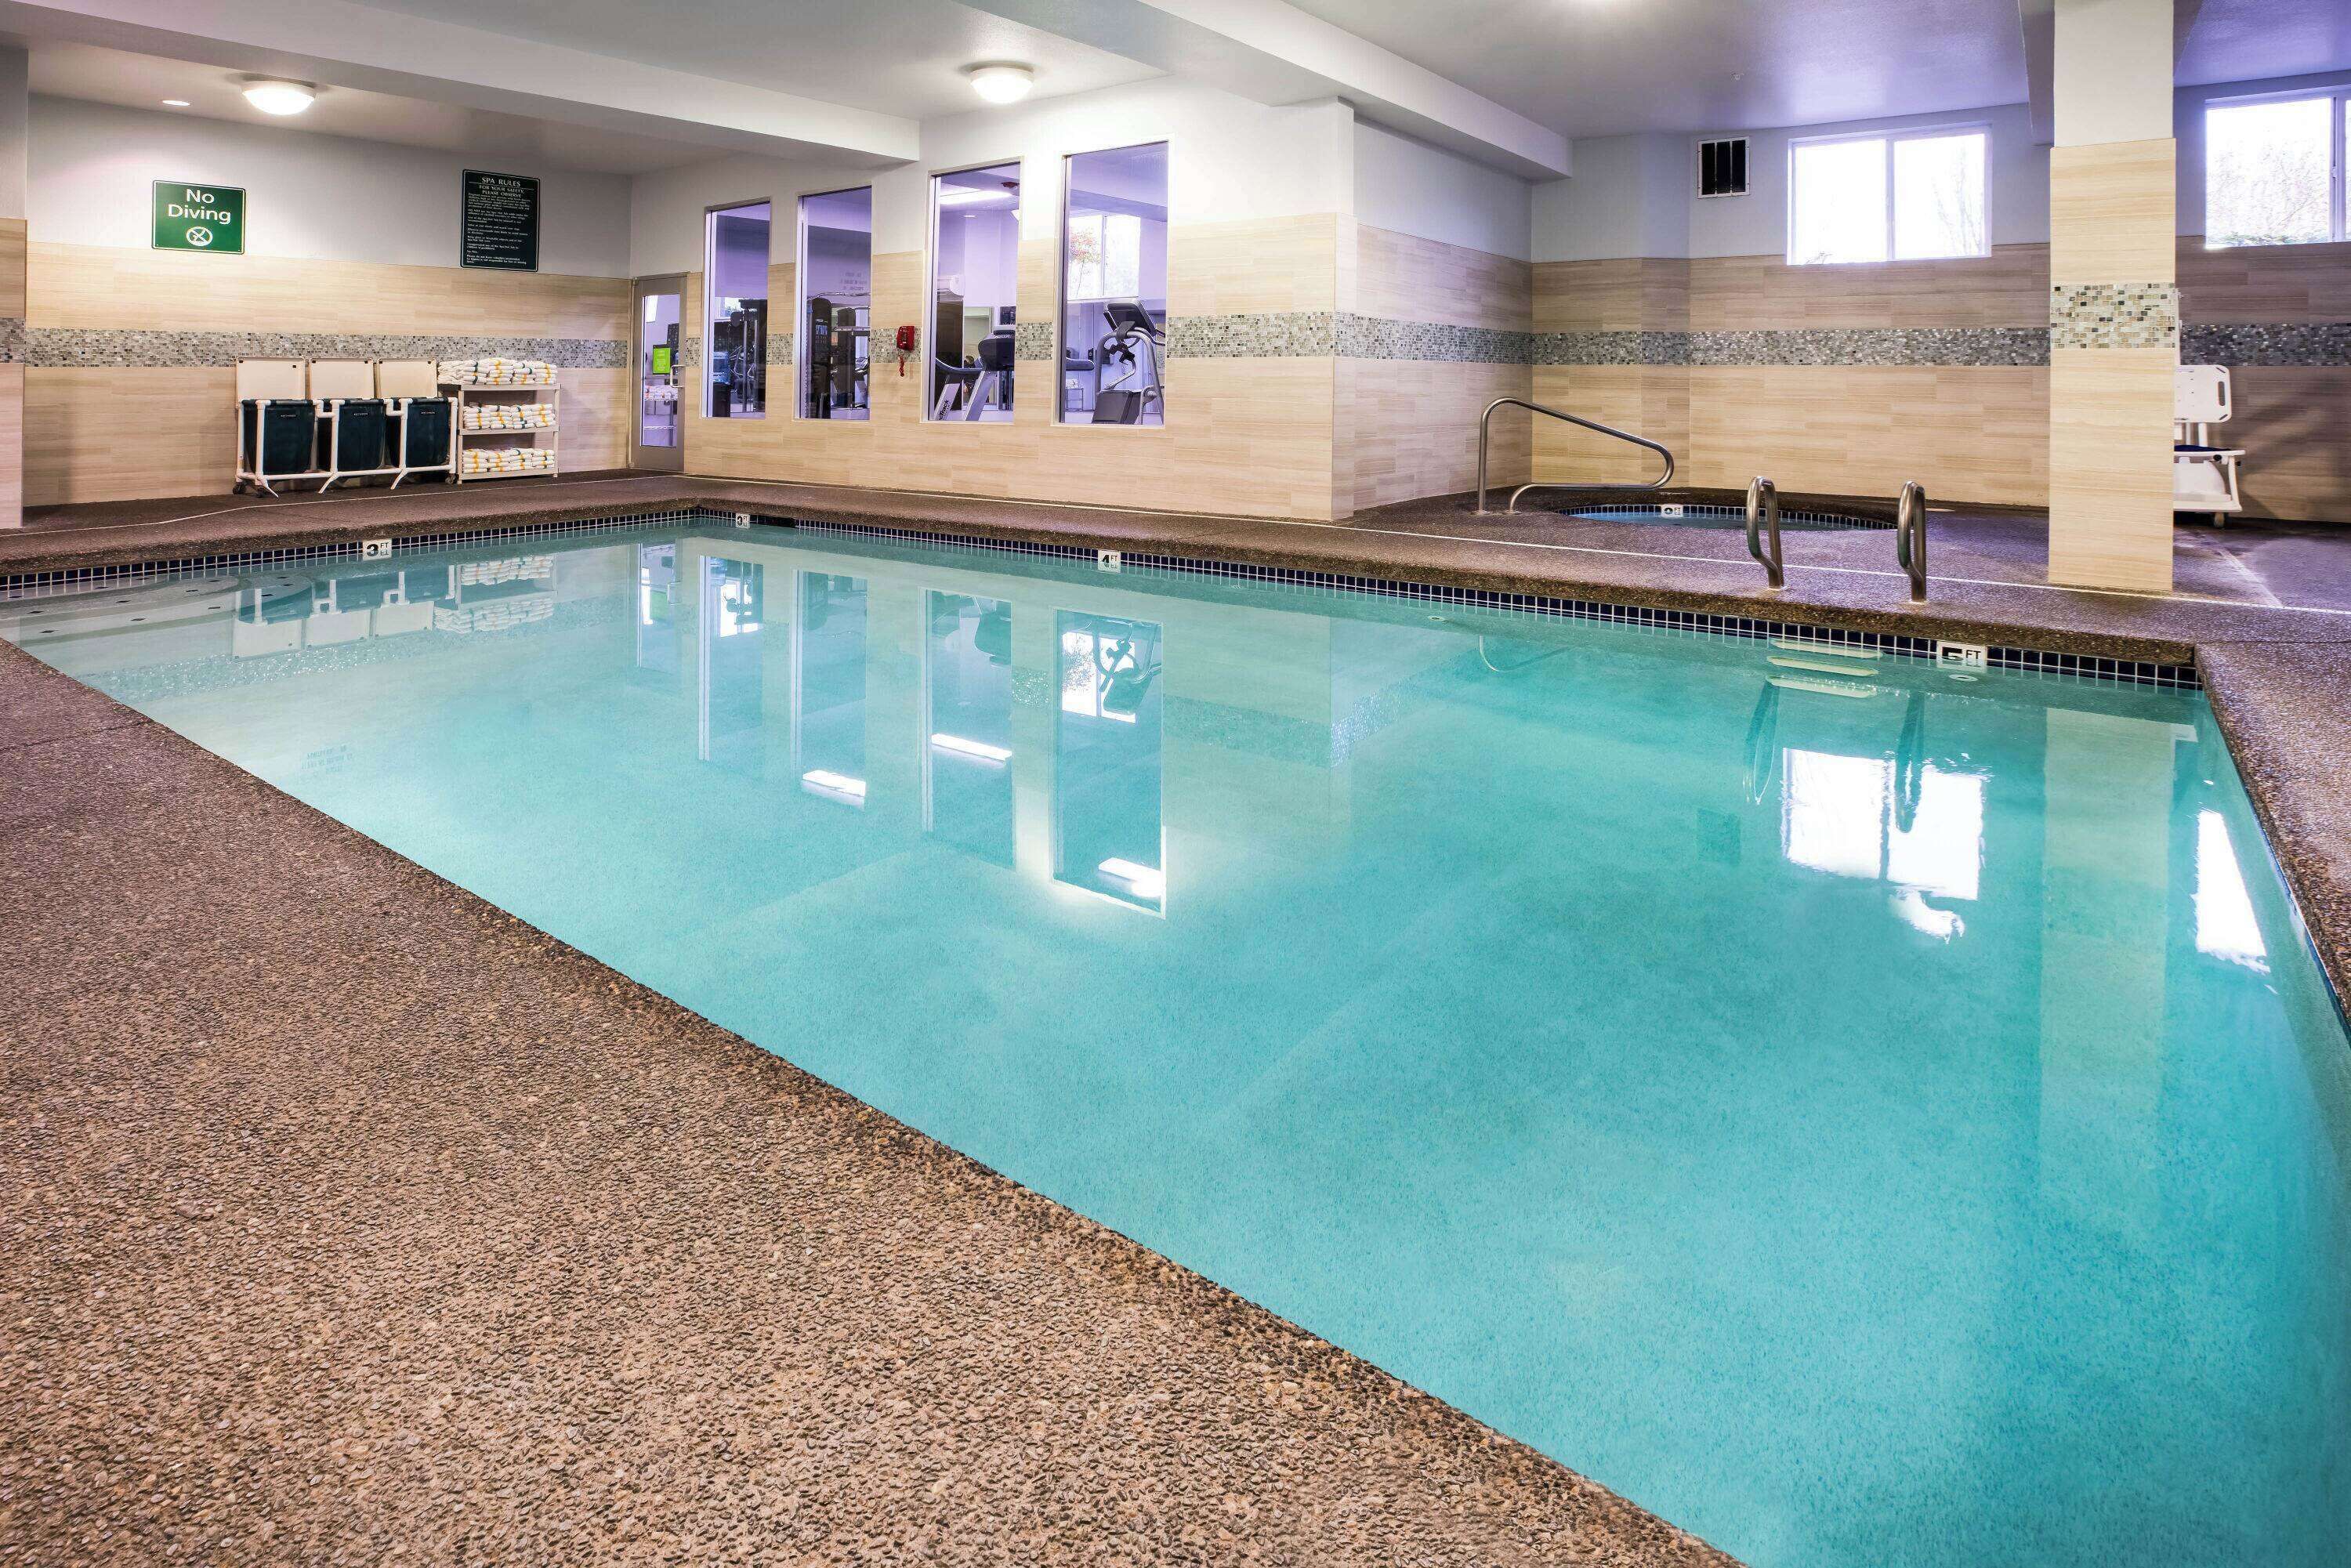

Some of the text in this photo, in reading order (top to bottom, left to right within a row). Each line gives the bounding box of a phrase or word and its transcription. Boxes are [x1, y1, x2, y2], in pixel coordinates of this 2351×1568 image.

[498, 179, 520, 187] RULES
[187, 188, 215, 204] No
[168, 204, 231, 224] Diving
[367, 543, 379, 556] 3
[1102, 554, 1110, 564] 4
[1965, 650, 1982, 660] FT
